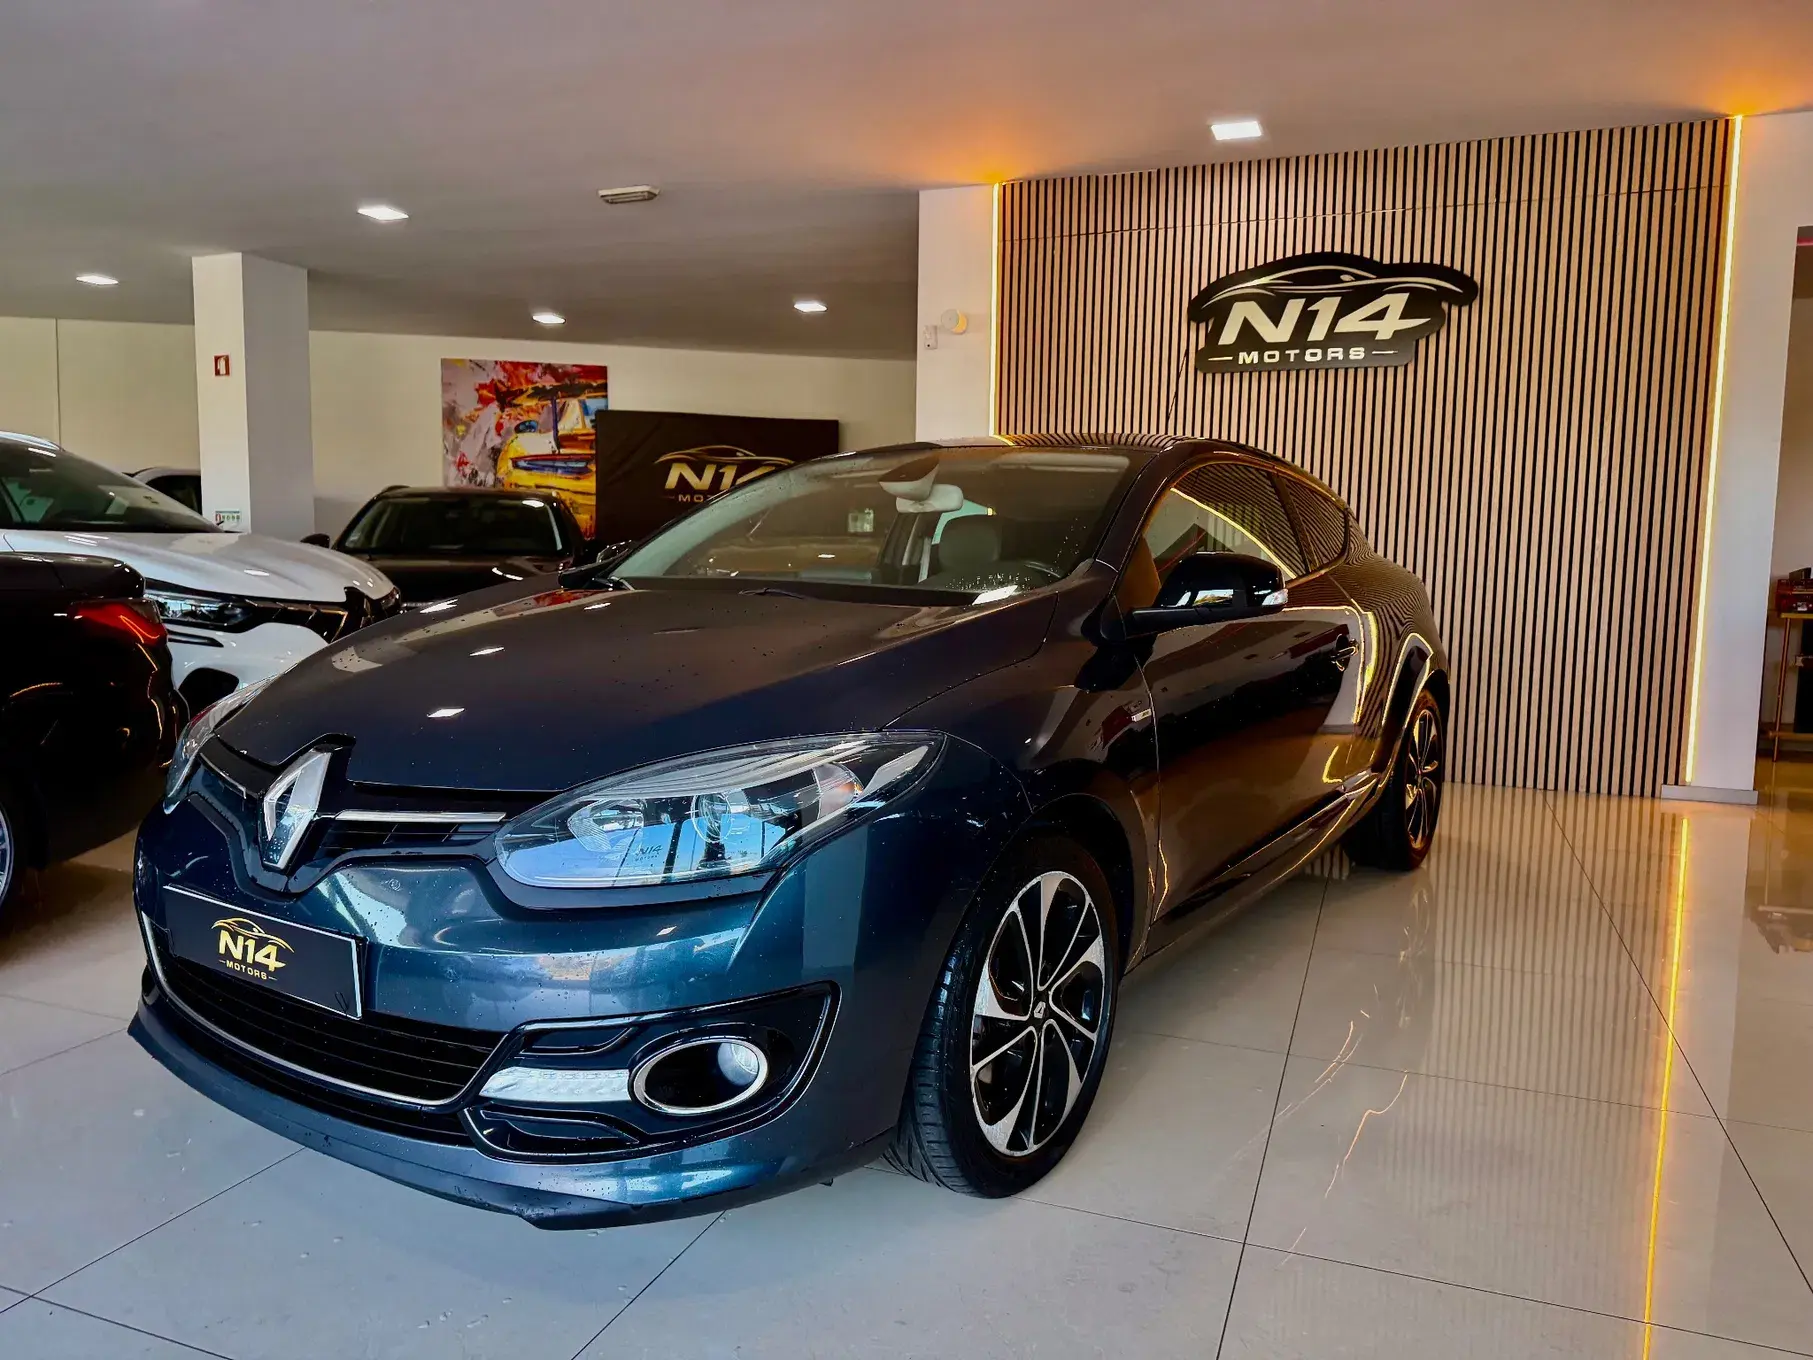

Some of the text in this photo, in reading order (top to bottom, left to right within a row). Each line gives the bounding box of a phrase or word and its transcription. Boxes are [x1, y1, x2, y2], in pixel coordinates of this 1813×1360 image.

[1218, 292, 1431, 345] N14
[1238, 347, 1366, 364] MOTORS
[219, 929, 286, 972] N14
[226, 960, 267, 980] MOTORS
